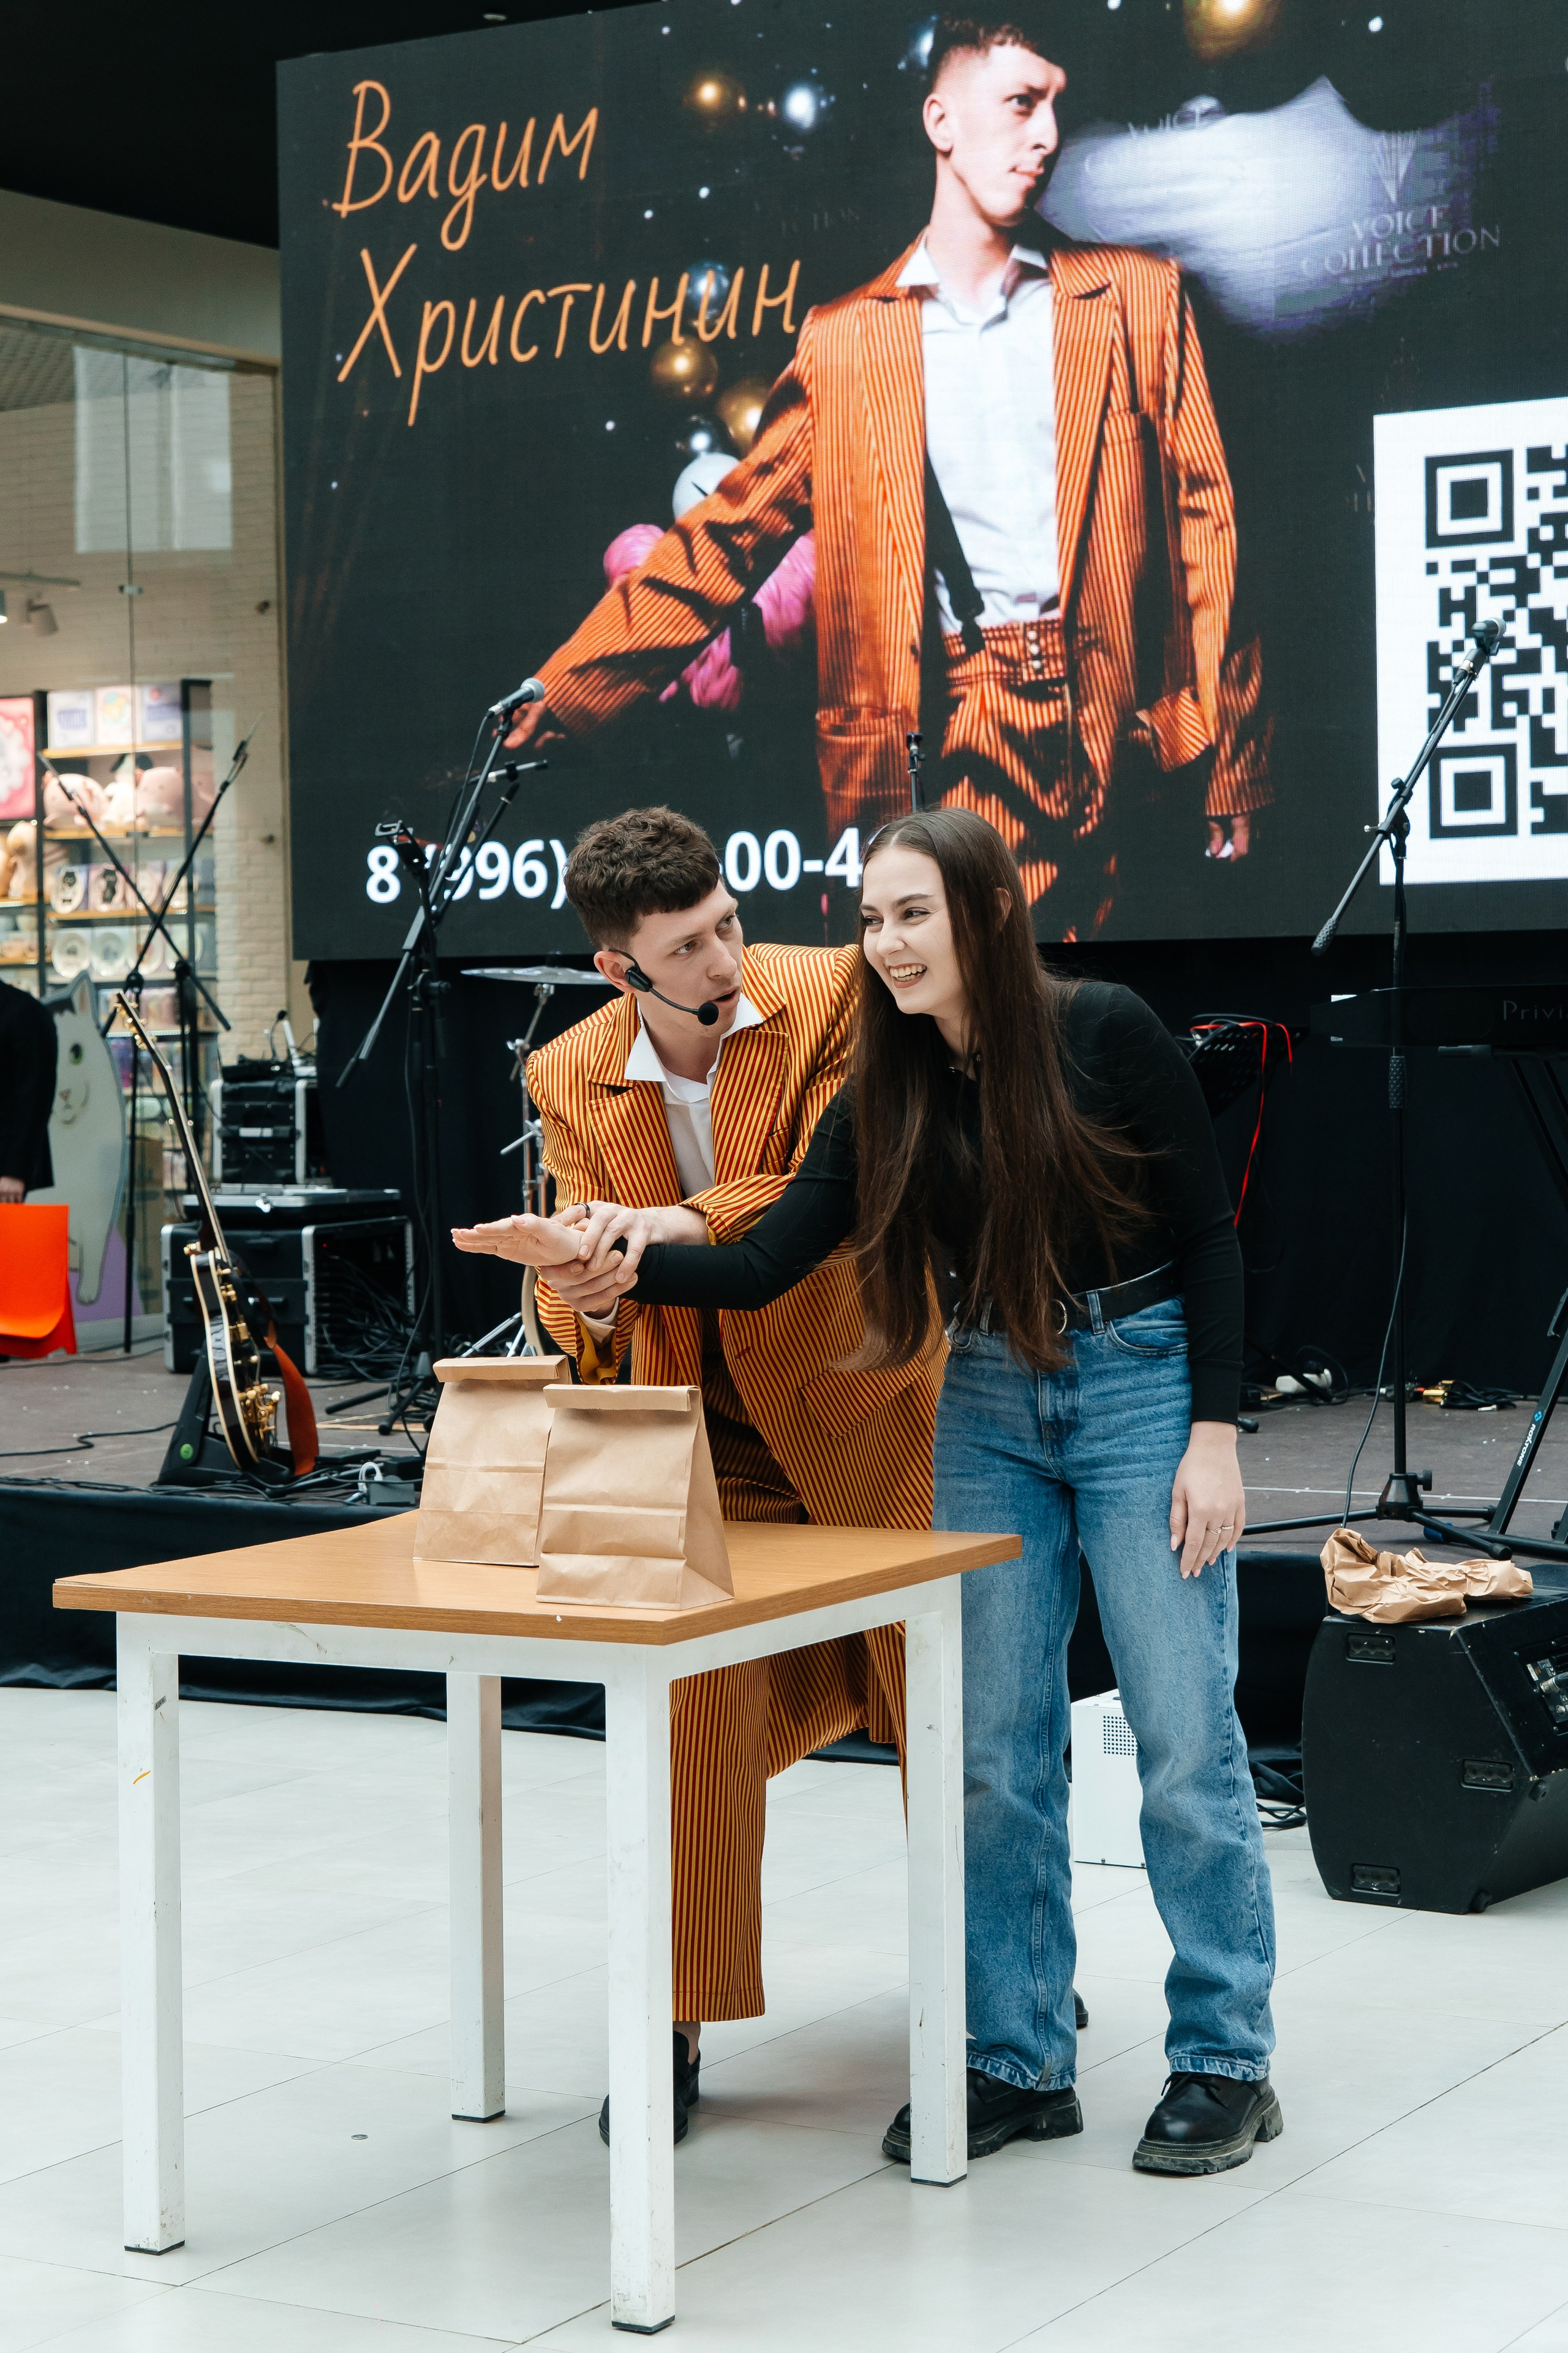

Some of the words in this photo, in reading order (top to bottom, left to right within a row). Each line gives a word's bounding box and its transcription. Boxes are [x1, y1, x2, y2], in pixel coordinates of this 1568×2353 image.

[331, 80, 598, 250] Вадим
[337, 243, 801, 426] Христинин
[1503, 1000, 1568, 1021] Privi
[1517, 1423, 1536, 1467] ROXTONE
